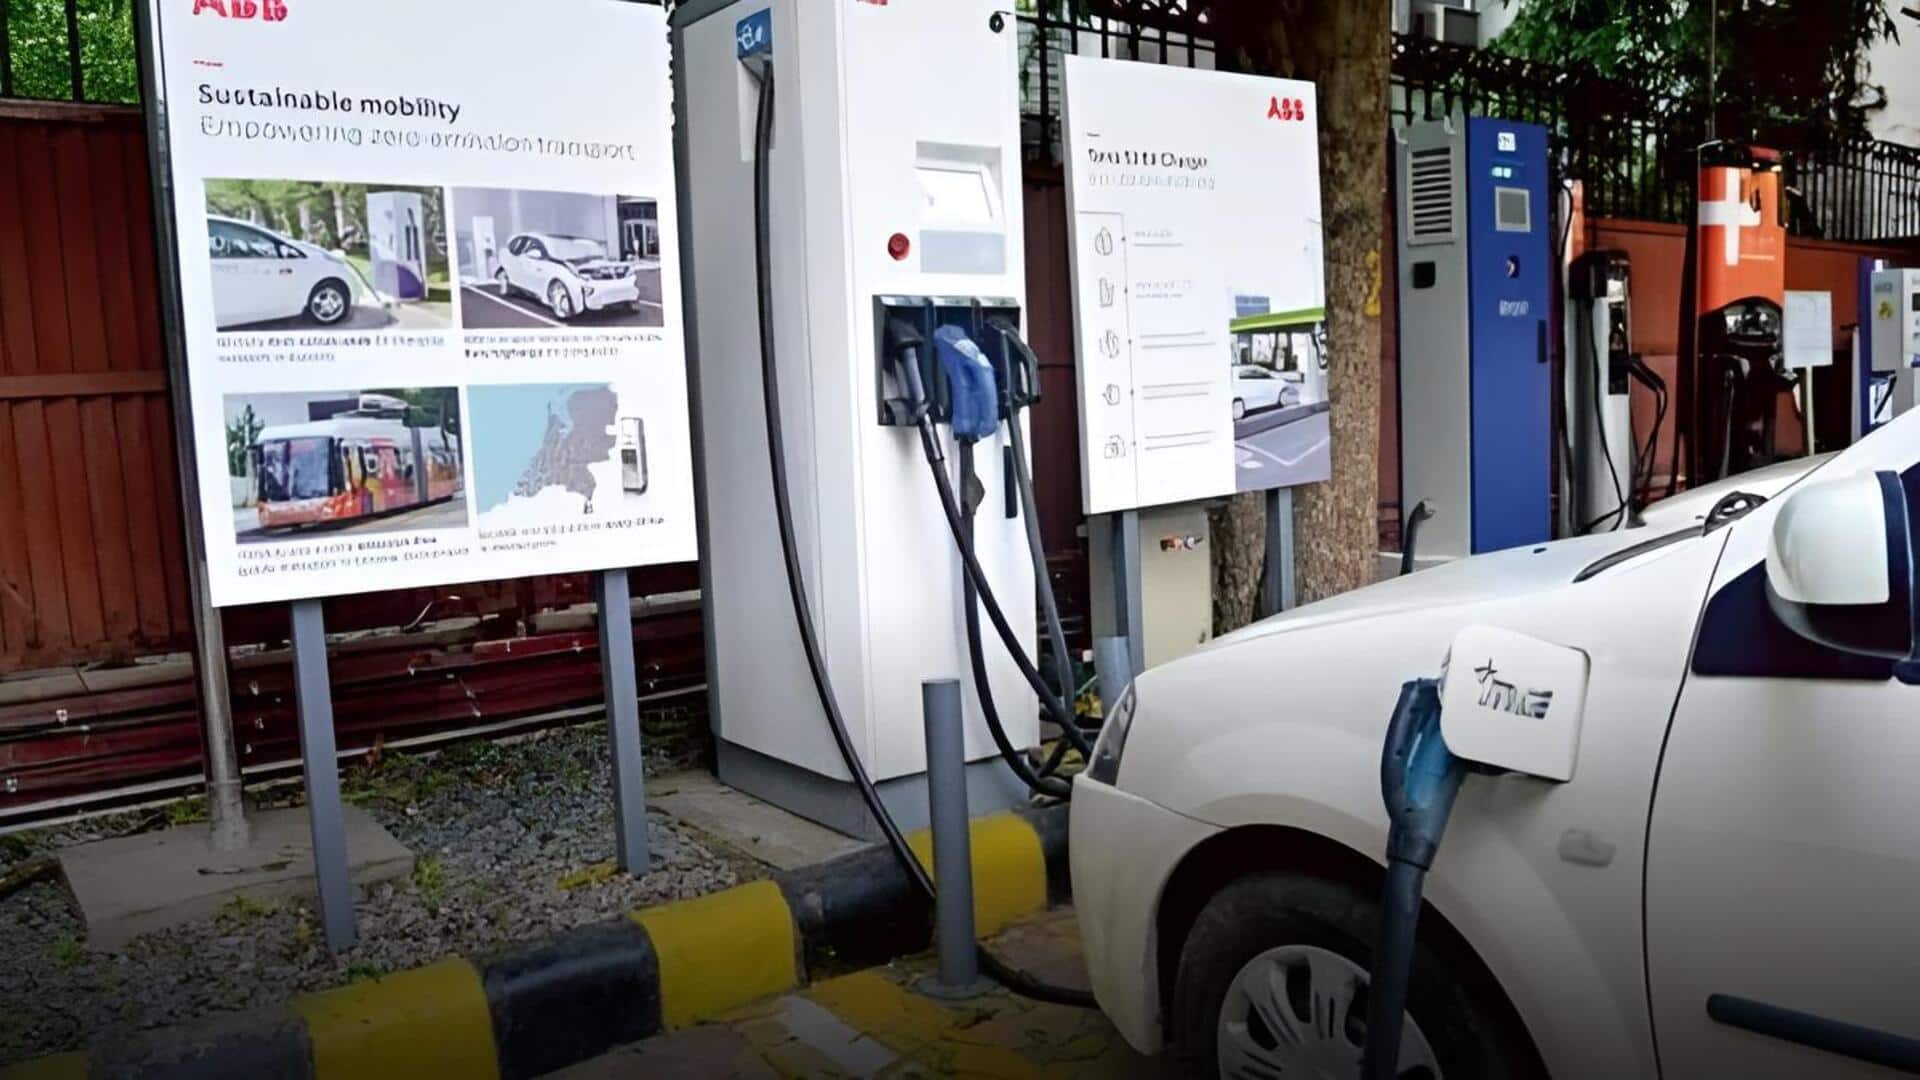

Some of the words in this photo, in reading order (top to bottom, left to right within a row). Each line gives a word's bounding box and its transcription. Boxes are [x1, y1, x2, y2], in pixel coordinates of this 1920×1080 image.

[199, 84, 352, 112] Sustainable
[360, 95, 460, 124] mobility
[1267, 96, 1305, 121] ABB
